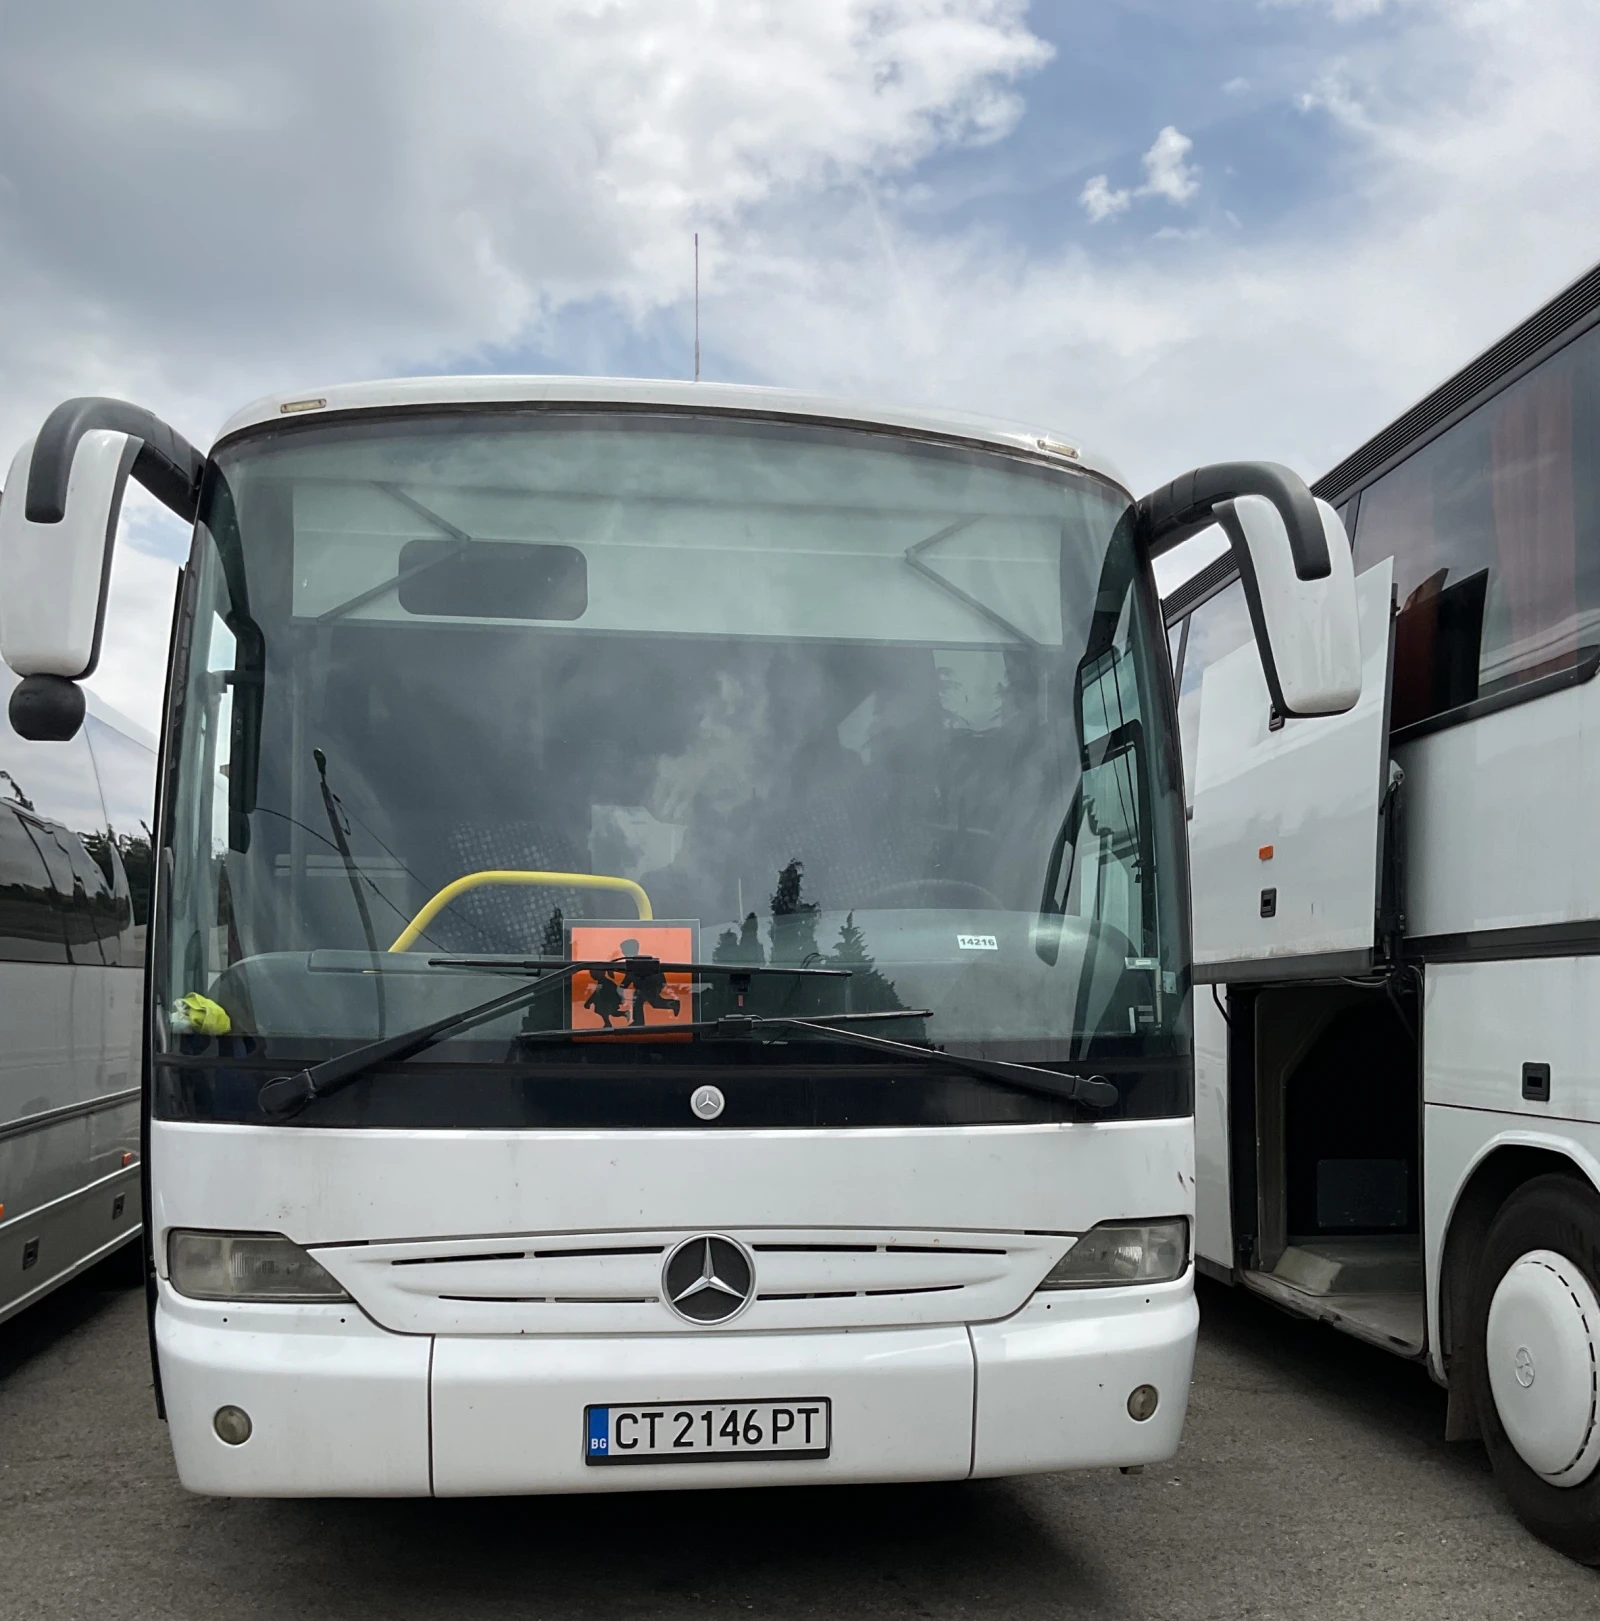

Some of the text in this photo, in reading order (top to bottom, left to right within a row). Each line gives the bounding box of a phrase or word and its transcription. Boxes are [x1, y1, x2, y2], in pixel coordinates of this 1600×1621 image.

[960, 938, 995, 946] 14216
[615, 1408, 820, 1449] CT 2146 PT
[591, 1438, 607, 1449] BG
